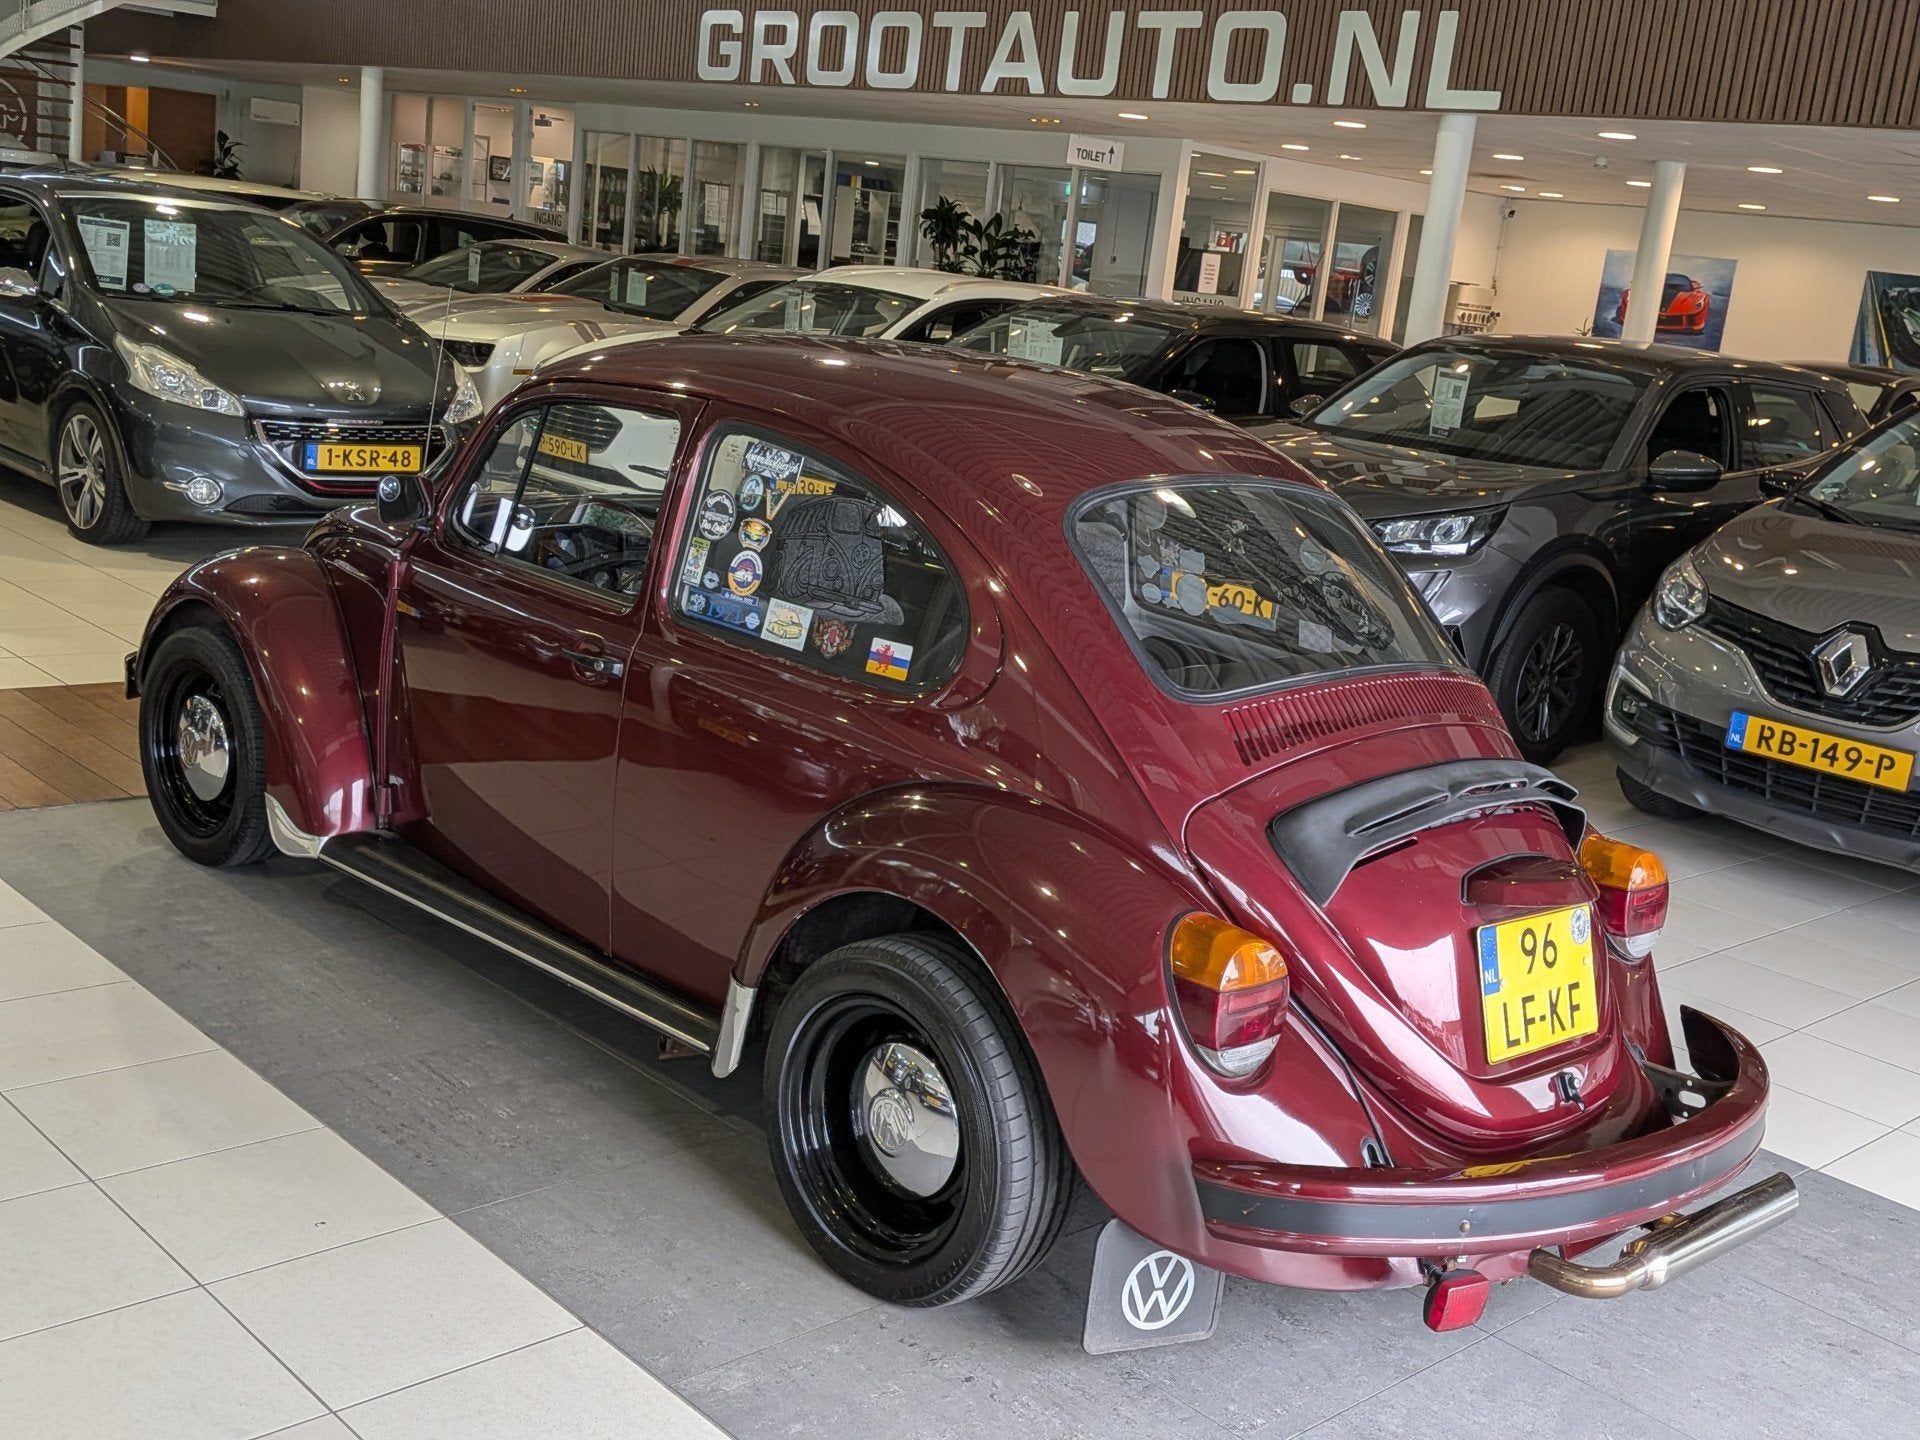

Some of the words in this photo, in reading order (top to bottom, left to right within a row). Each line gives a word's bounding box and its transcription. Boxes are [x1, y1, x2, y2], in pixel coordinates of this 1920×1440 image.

[696, 9, 1502, 110] GROOTAUTO.NL
[1076, 147, 1106, 164] TOILET
[533, 211, 562, 227] INGANG
[326, 448, 412, 468] 1-KSR-48
[1730, 732, 1742, 744] NL
[1756, 724, 1896, 779] RB-149-P
[1520, 922, 1558, 975] 96
[1484, 968, 1498, 985] NL
[1502, 981, 1581, 1049] LF-KF
[1124, 1251, 1192, 1328] VW
